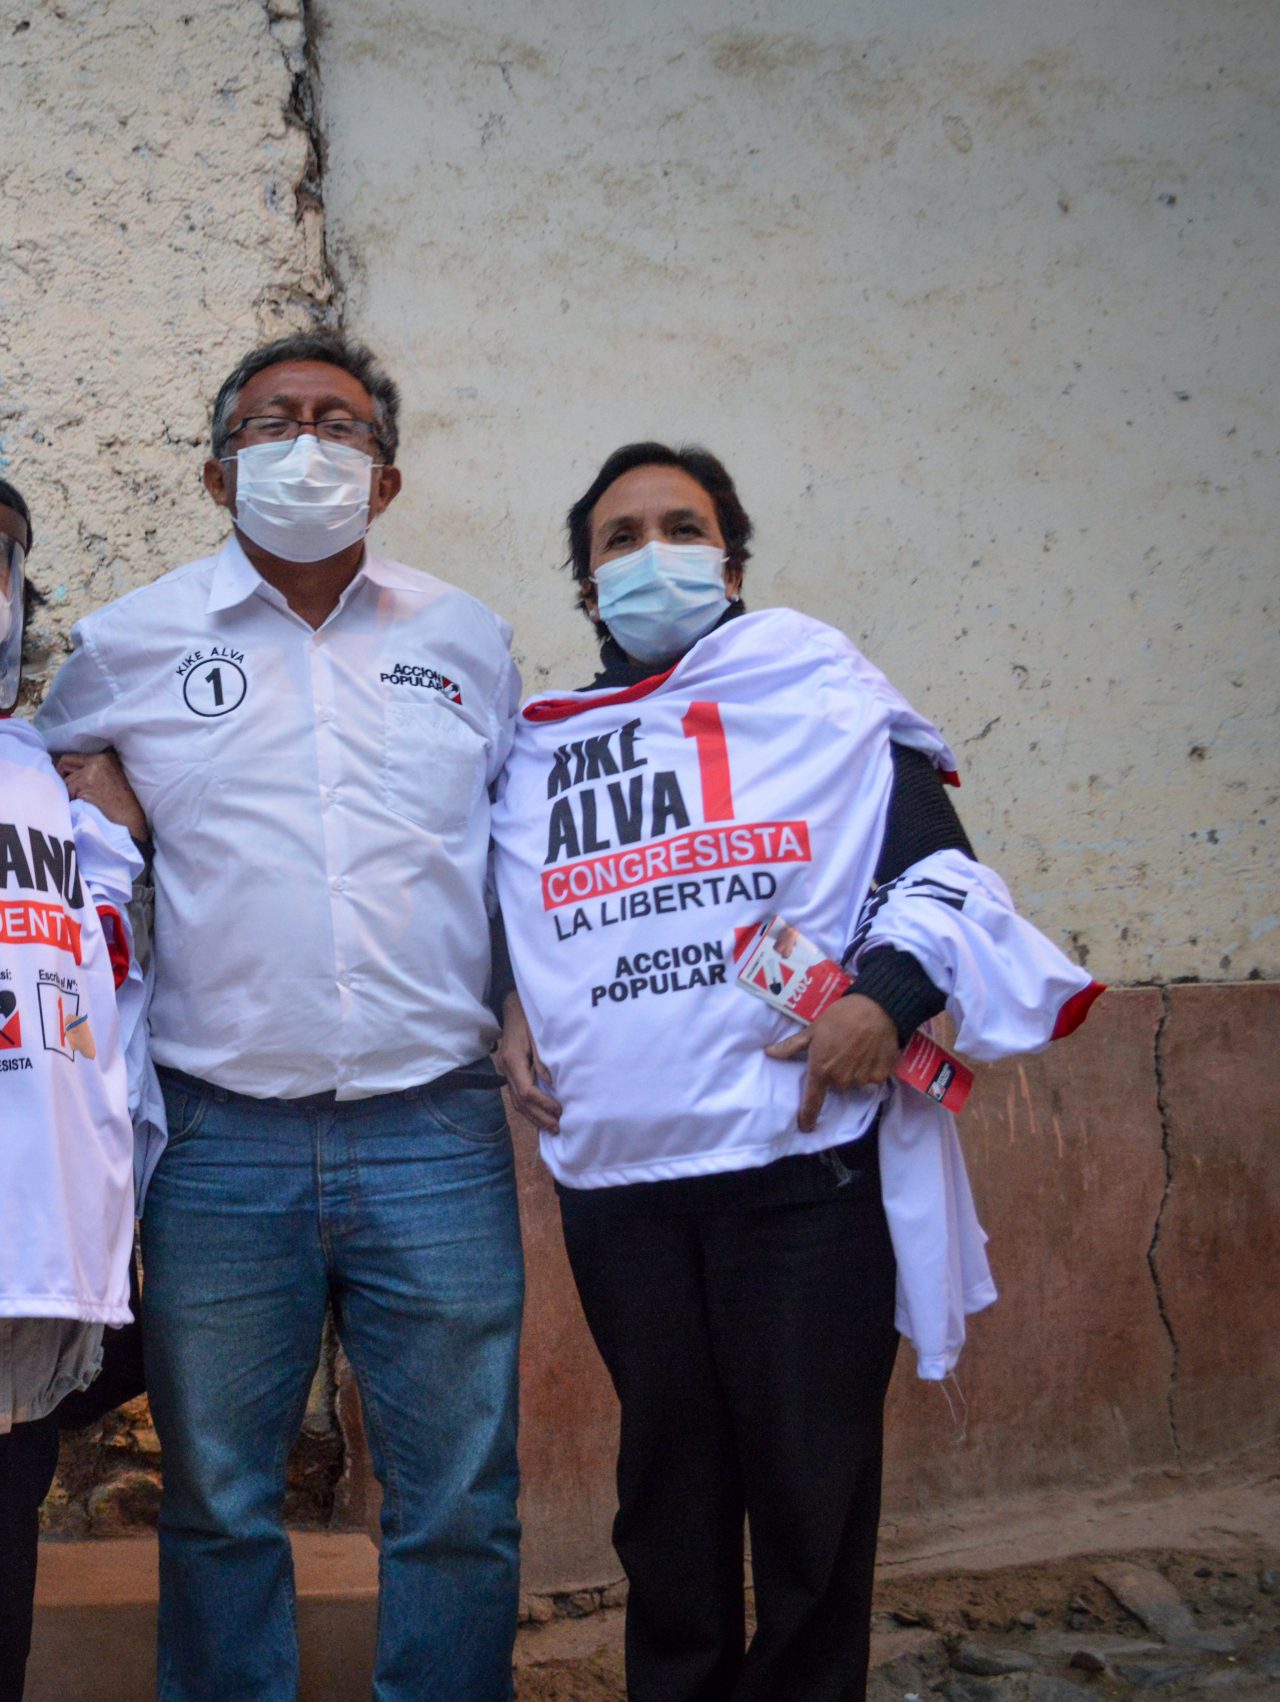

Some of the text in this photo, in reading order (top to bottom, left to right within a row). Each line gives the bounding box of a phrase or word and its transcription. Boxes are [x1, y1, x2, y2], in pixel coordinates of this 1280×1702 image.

[176, 647, 245, 676] KIKE ALVA
[380, 673, 442, 690] POPULAR
[393, 663, 441, 682] ACCION
[205, 667, 224, 706] 1
[548, 717, 648, 800] KIKE
[681, 702, 735, 823] 1
[544, 771, 691, 865] ALVA
[547, 827, 804, 903] CONGRESISTA
[554, 872, 777, 942] LA LIBERTAD
[615, 940, 724, 978] ACCION
[591, 964, 727, 1008] POPULAR
